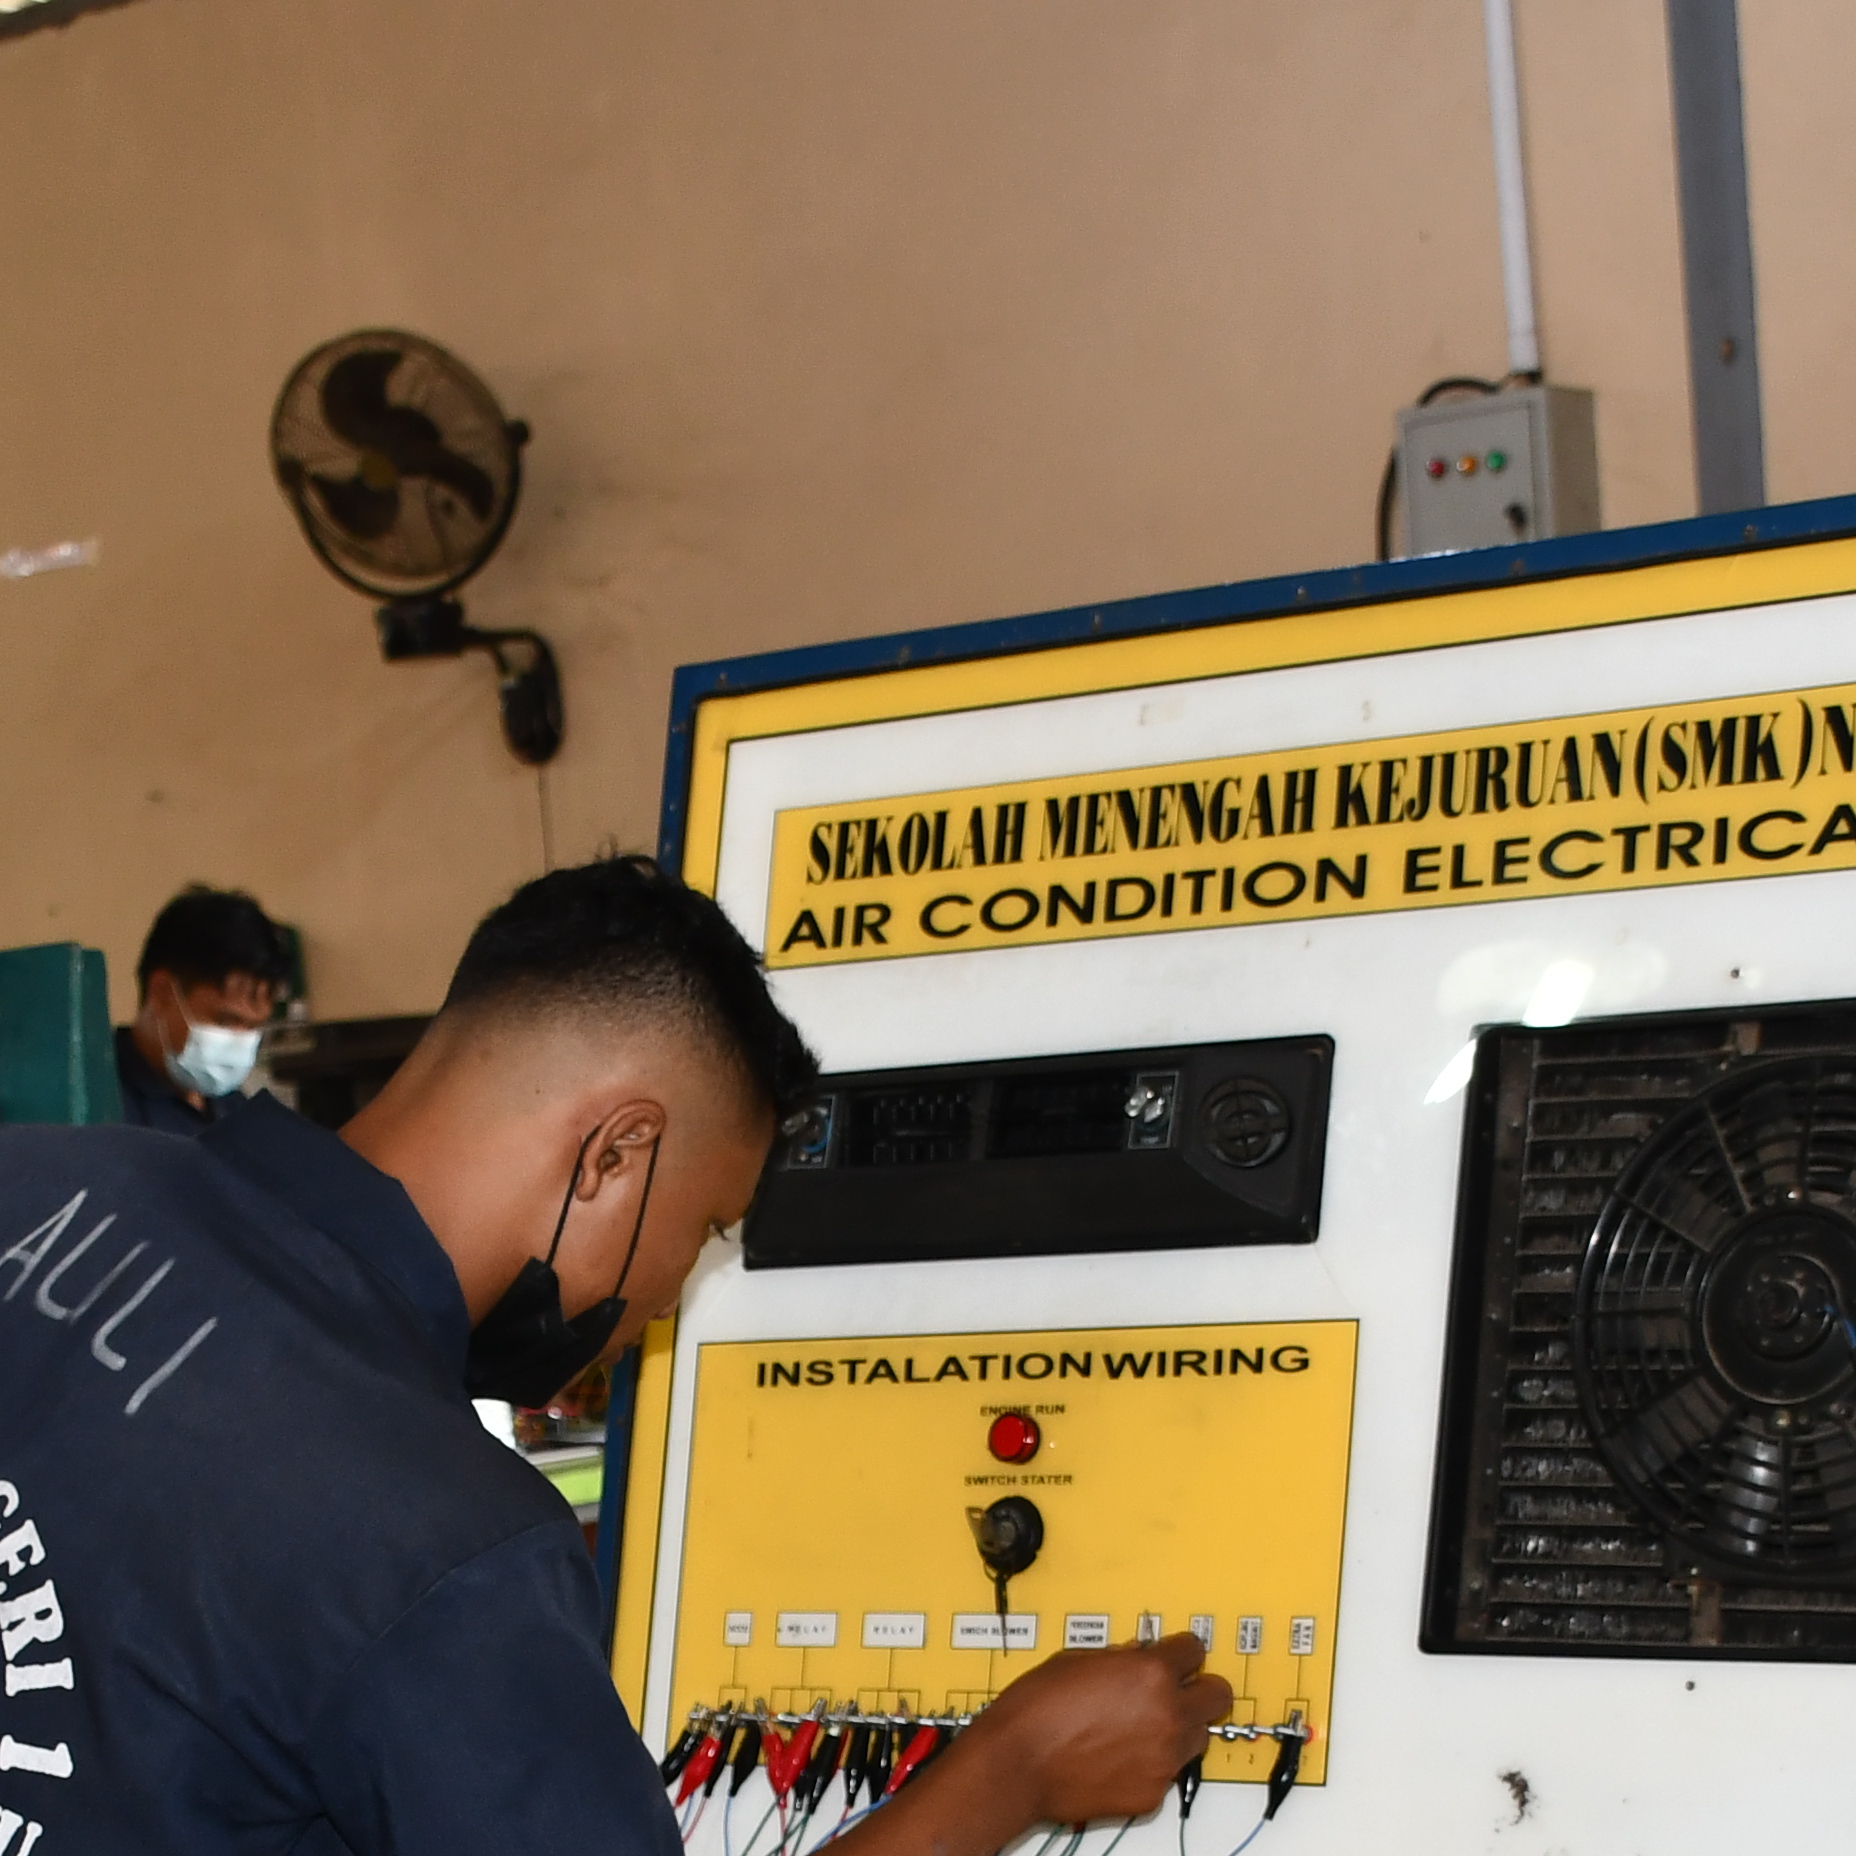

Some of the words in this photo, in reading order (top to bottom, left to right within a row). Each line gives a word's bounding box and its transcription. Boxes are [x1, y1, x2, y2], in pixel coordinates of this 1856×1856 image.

[806, 801, 1029, 886] SEKOLAH
[1038, 766, 1319, 862] MENENGAH
[1333, 728, 1628, 831] KEJURUAN
[781, 902, 892, 952] AIR
[919, 853, 1369, 940] CONDITION
[756, 1350, 1093, 1388] INSTALATION
[1102, 1344, 1311, 1380] WIRING
[1035, 1403, 1066, 1415] RUN
[964, 1475, 1017, 1487] SWITCH
[1020, 1474, 1073, 1486] STATER
